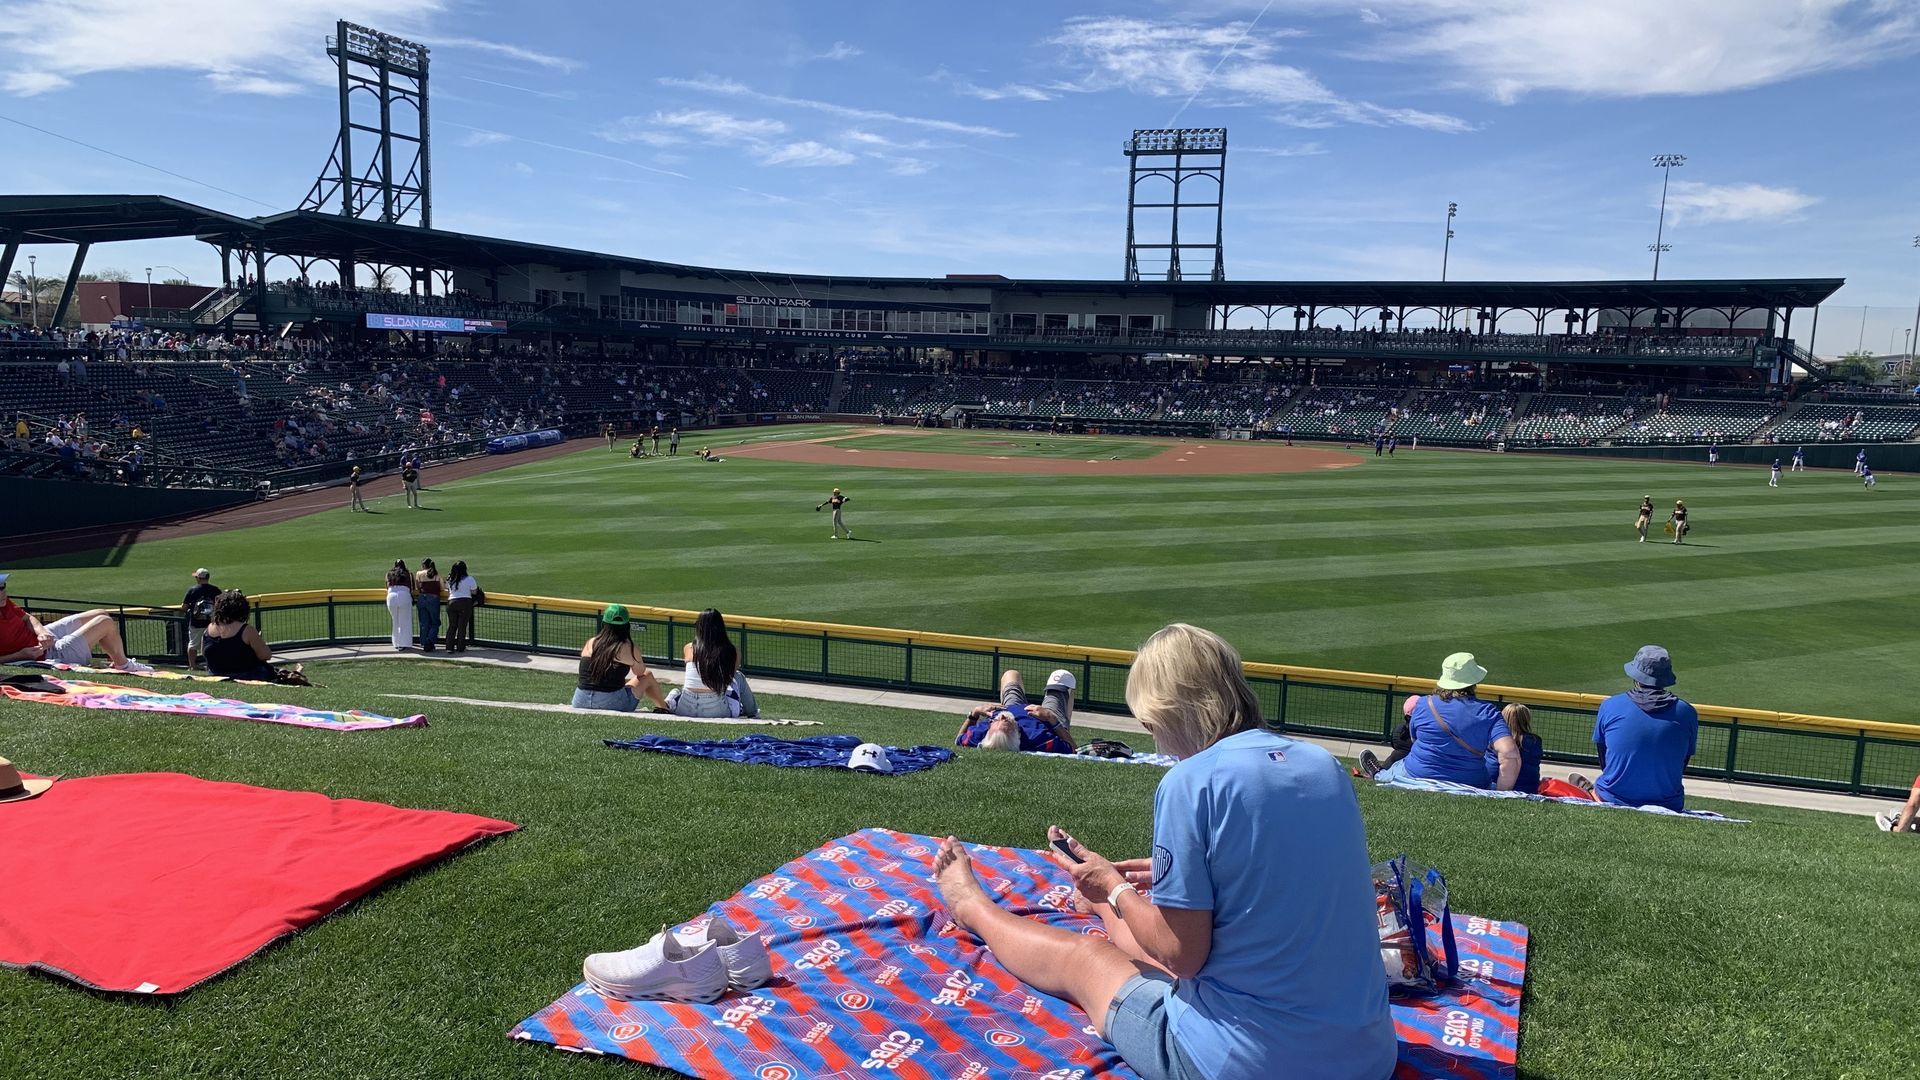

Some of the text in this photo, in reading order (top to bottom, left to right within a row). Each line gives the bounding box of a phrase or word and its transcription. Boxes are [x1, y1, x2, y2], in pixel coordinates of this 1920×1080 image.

[736, 295, 811, 307] SLOAN PARK
[383, 317, 448, 329] SLOAN PARK
[794, 939, 841, 970] CUBS
[931, 969, 972, 1006] CUBS
[801, 1021, 827, 1044] CUBS
[1442, 1010, 1470, 1047] CUBS
[1469, 1017, 1485, 1049] CHICAGO
[861, 1030, 911, 1069] CUBS
[886, 1038, 925, 1069] CHICAGO
